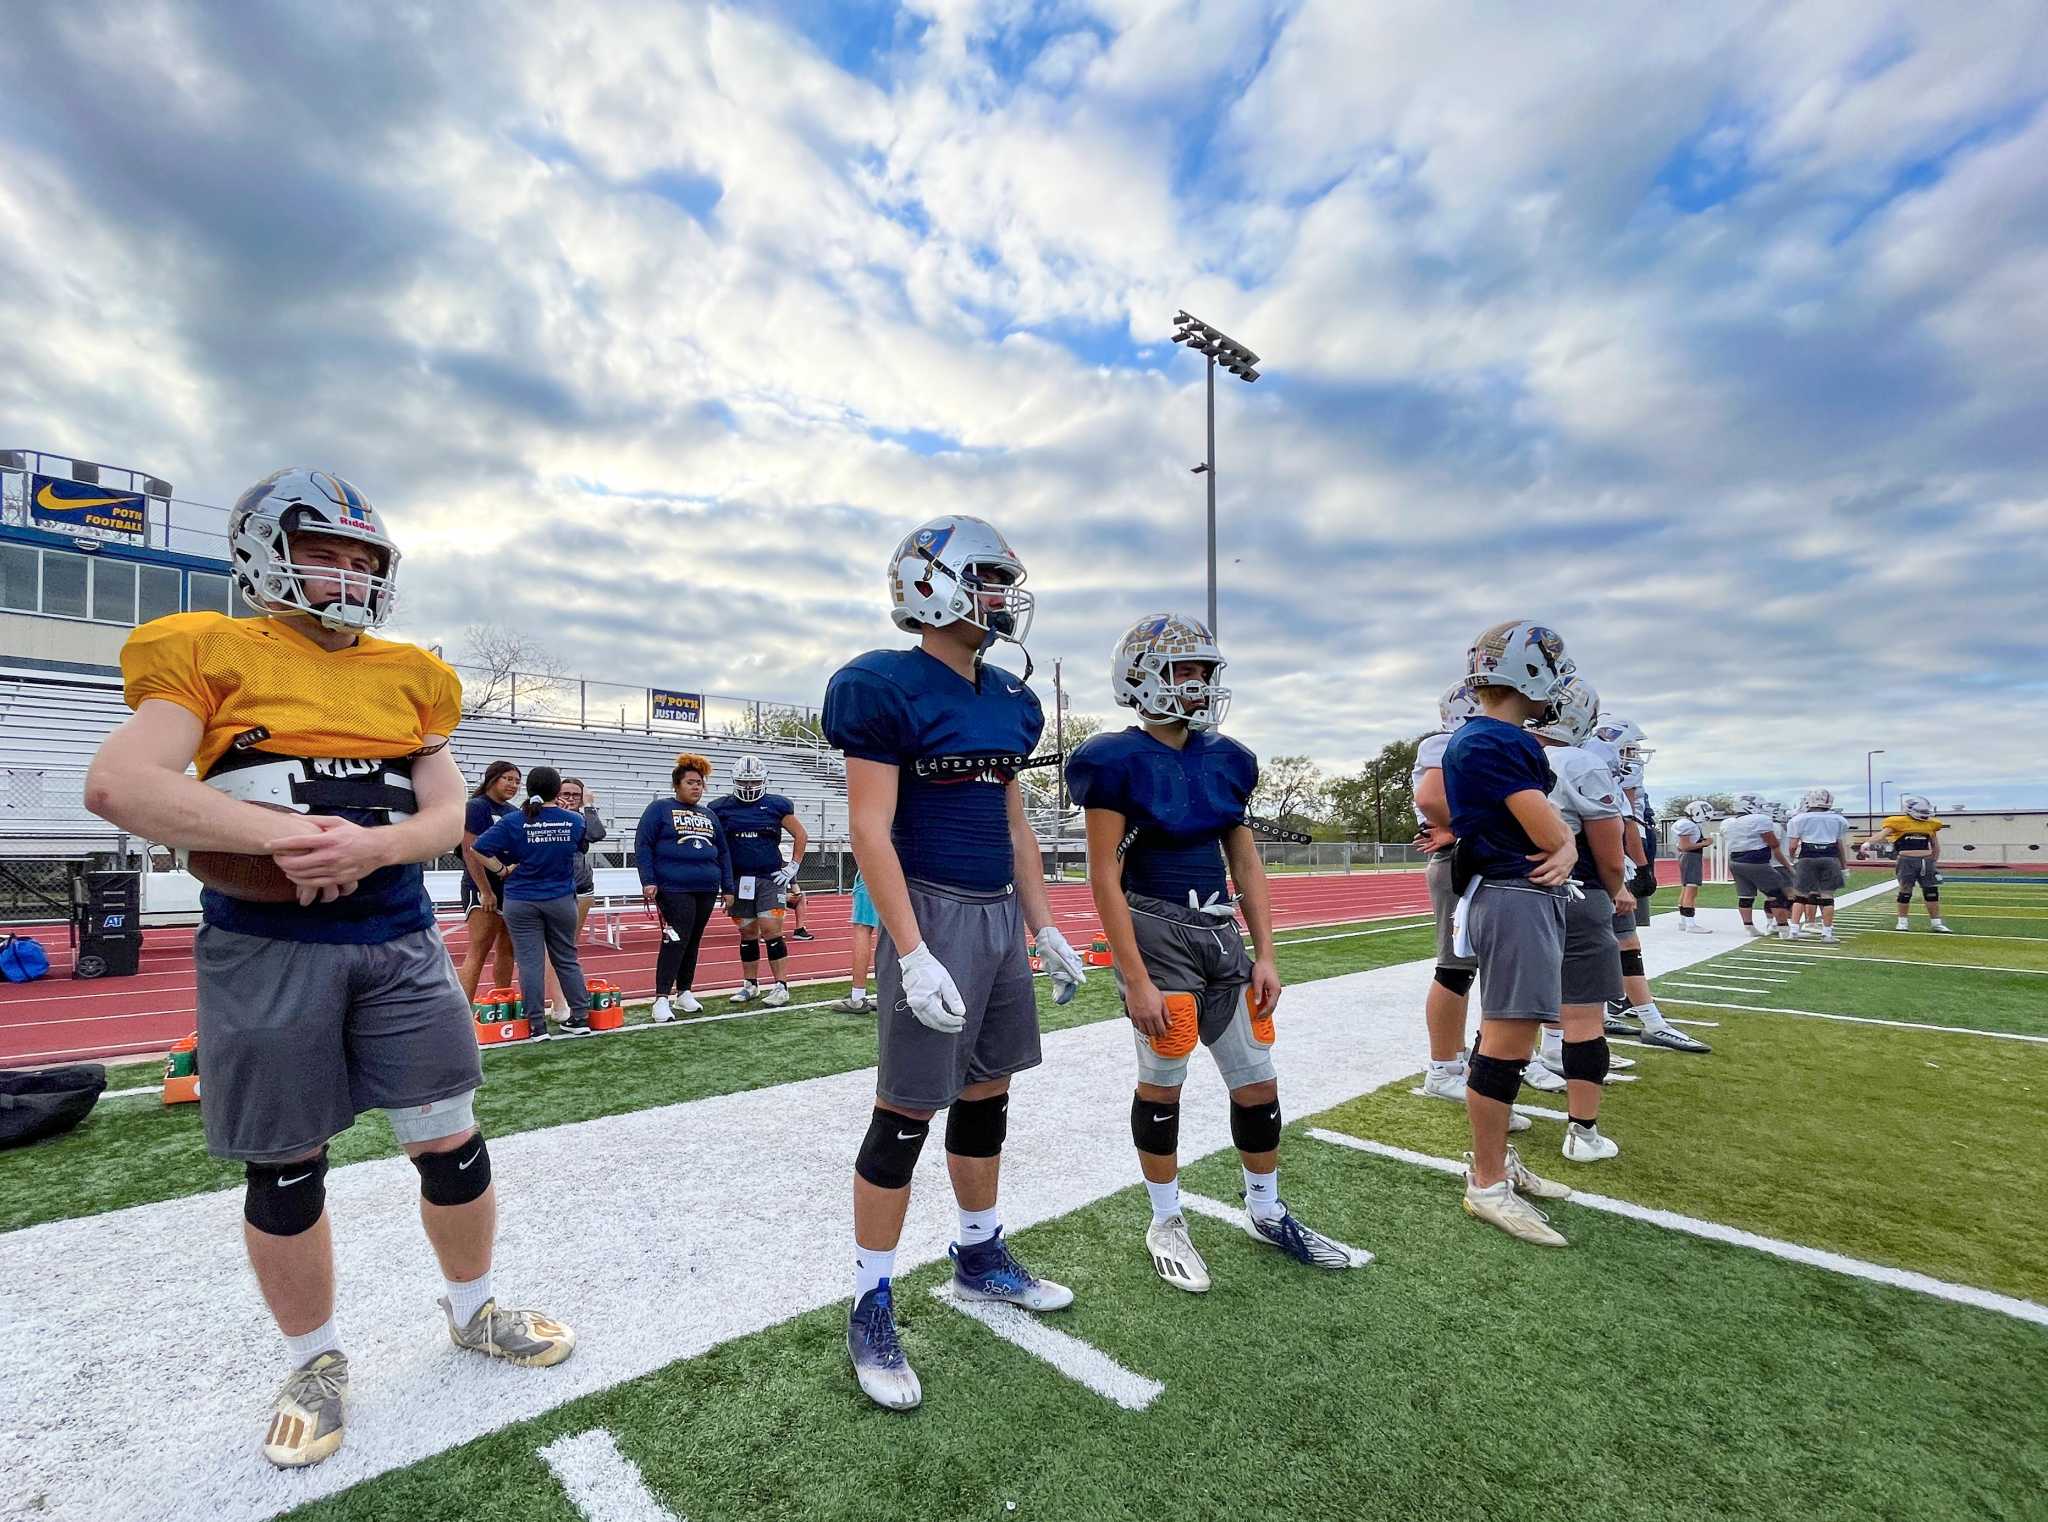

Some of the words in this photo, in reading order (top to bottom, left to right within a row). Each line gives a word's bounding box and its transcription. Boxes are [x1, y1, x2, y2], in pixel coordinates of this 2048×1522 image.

[112, 507, 143, 520] POTH
[85, 514, 143, 531] FOOTBALL
[339, 516, 376, 533] Riddell
[667, 696, 700, 709] POTH
[655, 708, 675, 719] JUST
[675, 710, 688, 721] DO
[688, 711, 698, 722] IT.
[103, 914, 125, 928] AT
[600, 998, 609, 1008] G
[486, 1010, 496, 1021] G
